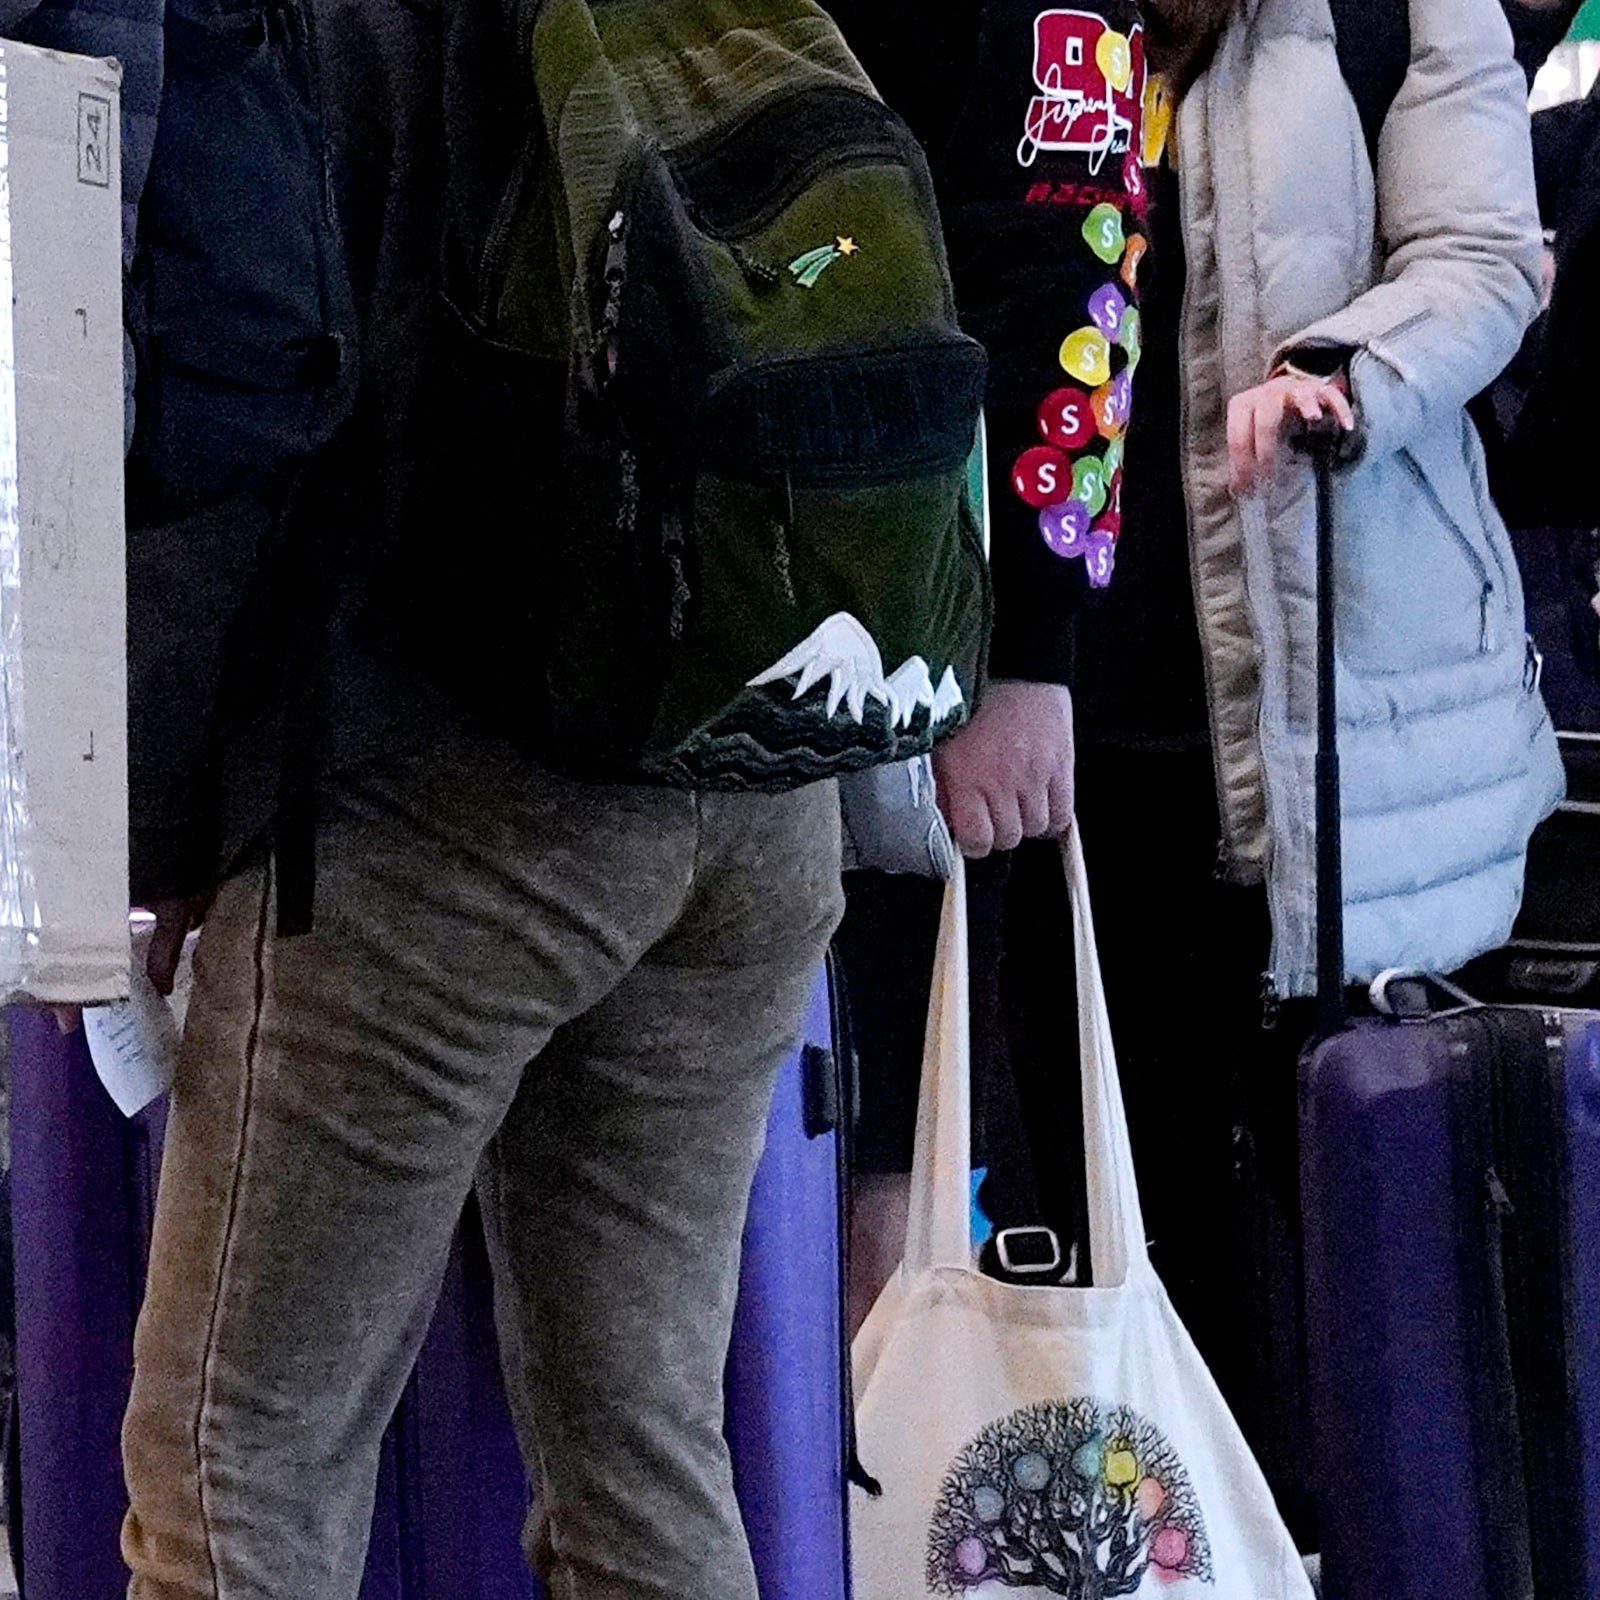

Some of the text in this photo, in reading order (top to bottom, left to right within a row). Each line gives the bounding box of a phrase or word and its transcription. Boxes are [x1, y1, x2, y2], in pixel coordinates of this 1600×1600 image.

[1101, 219, 1115, 248] S
[1105, 299, 1117, 328] S
[1080, 343, 1099, 373] S
[1060, 405, 1080, 435] S
[1036, 463, 1057, 494] S
[1080, 472, 1096, 503] S
[1060, 515, 1076, 545] S
[1097, 543, 1108, 576] S
